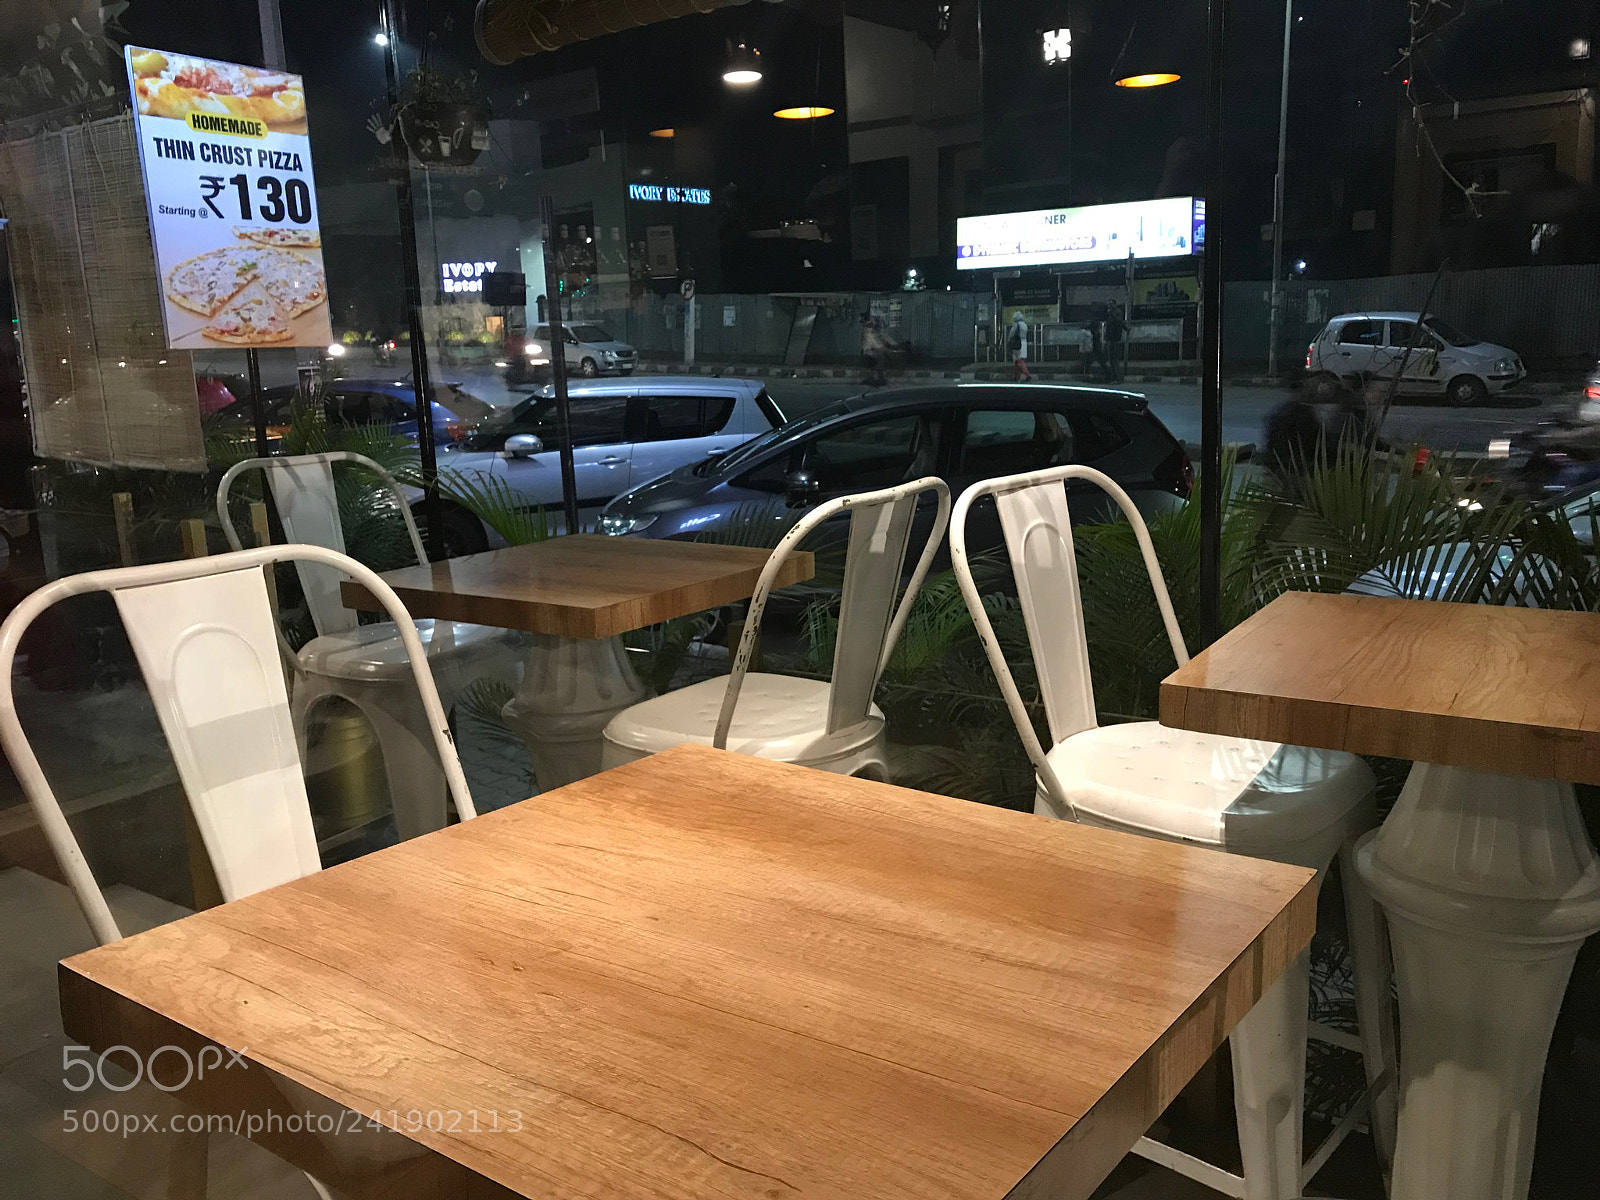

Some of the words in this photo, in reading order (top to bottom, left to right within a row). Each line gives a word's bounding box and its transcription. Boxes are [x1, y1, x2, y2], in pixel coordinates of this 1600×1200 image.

[191, 114, 263, 137] HOMEMADE
[154, 137, 195, 161] THIN
[200, 143, 252, 167] CRUST
[258, 149, 303, 171] PIZZA
[629, 184, 663, 201] IVORY
[158, 204, 196, 218] Starting
[442, 261, 498, 278] IVORY
